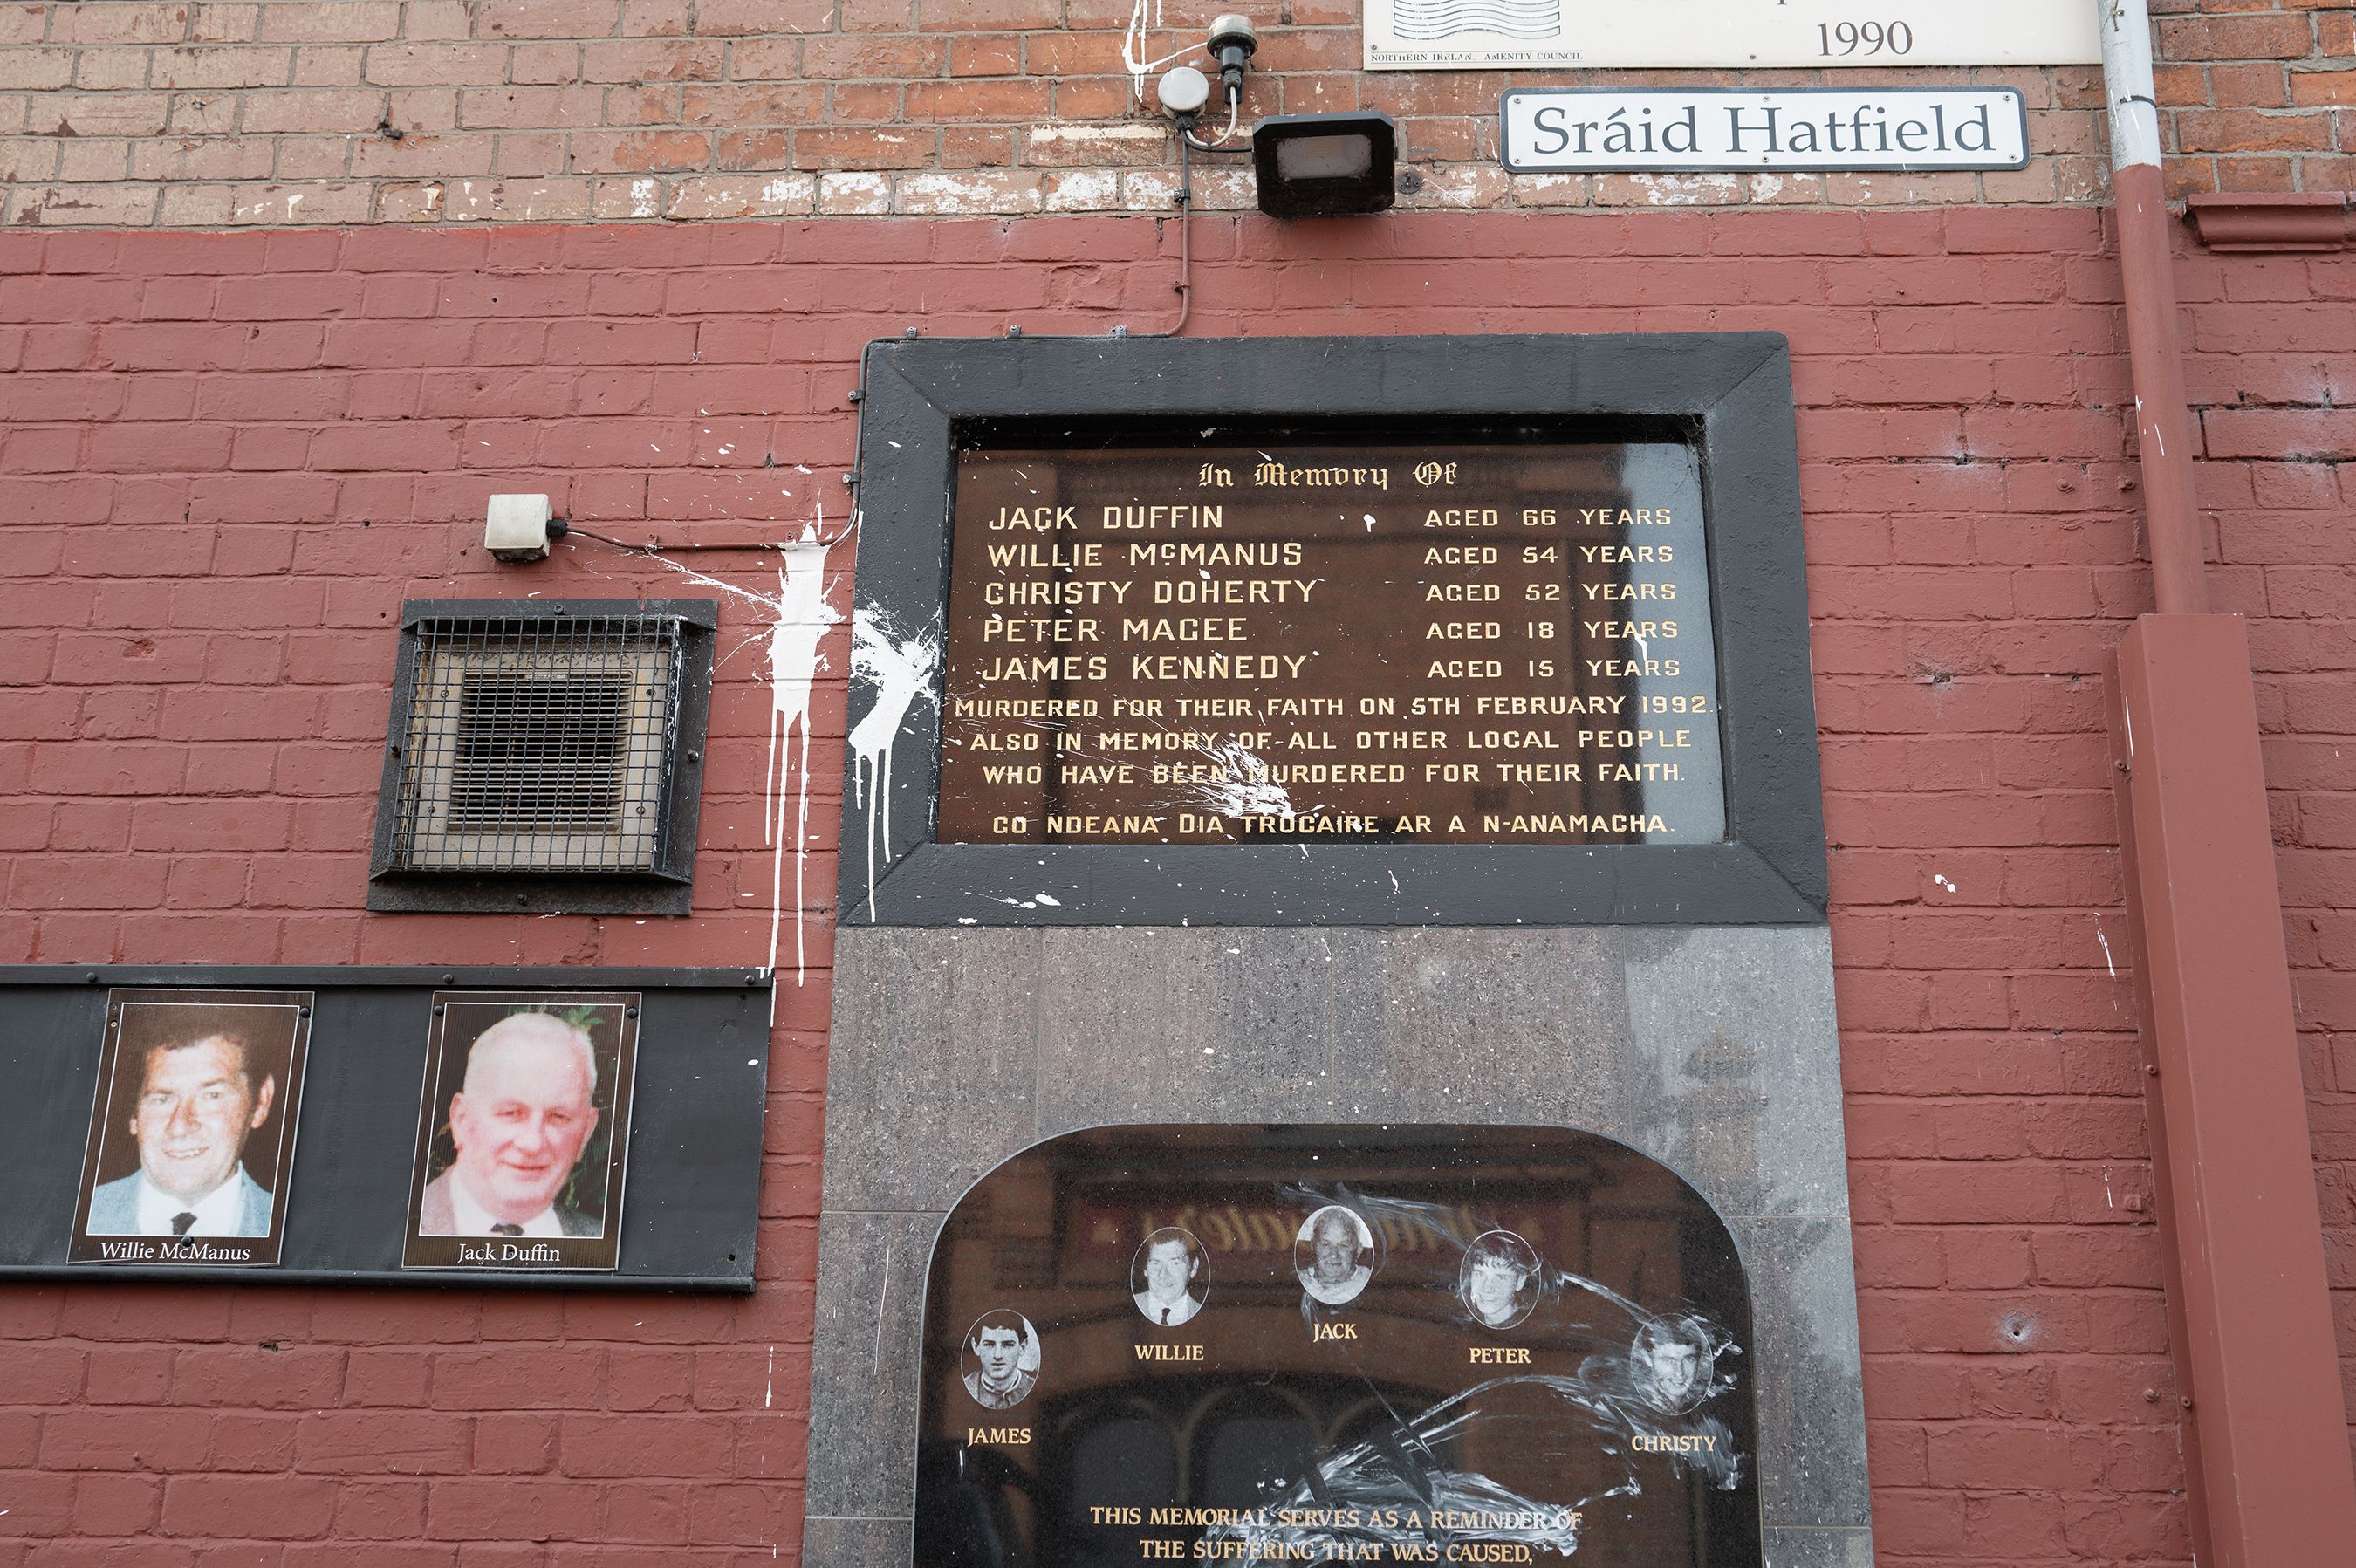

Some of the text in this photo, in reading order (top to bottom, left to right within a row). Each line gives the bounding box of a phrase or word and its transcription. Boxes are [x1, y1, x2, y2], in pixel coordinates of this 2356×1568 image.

[1817, 20, 1913, 56] 1990
[1533, 103, 1996, 154] Sráid Hatfield
[1199, 462, 1457, 490] In Memory Of
[988, 505, 1671, 531] JACK DUFFIN AGED 66 YEARS
[988, 543, 1673, 567] WILLIE McMANUS AGED 54 YEARS
[985, 580, 1676, 605] CHRISTY DOHERTY AGED 52 YEARS
[983, 618, 1678, 642] PETER MAGEE AGED 18 YEARS
[982, 655, 1681, 681] JAMES KENNEDY AGED 15 YEARS
[955, 700, 1098, 717] MURDERED
[1113, 699, 1163, 716] FOR
[1176, 699, 1252, 716] THEIR
[1267, 698, 1343, 716] FAITH
[1360, 698, 1394, 715] ON
[1411, 697, 1460, 715] 5TH
[1477, 696, 1626, 715] FEBRUARY
[969, 729, 1691, 750] ALSO IN MEMORY OF ALL OTHER LOCAL PEOPLE
[983, 763, 1685, 784] WHO HAVE BEEN MURDERED FOR THEIR FAITH.
[1048, 816, 1160, 834] NDEANA
[1179, 814, 1225, 833] DIA
[1241, 816, 1379, 833] TROCAIRE
[1394, 815, 1432, 833] AR
[1447, 815, 1466, 832] A
[1483, 814, 1675, 832] N-ANAMACHA.
[100, 1241, 250, 1261] Willie McManus
[457, 1243, 561, 1263] Jack Duffin
[1312, 1322, 1358, 1341] JACK
[1134, 1345, 1205, 1362] WILLIE
[1469, 1346, 1531, 1365] PETER
[967, 1427, 1031, 1447] JAMES
[1631, 1435, 1717, 1452] CHRISTY
[1090, 1506, 1583, 1530] THIS MEMORIAL SERVES AS A REMINDER OF
[1140, 1539, 1533, 1565] THE SUFFERING THAT WAS CAUSED,
